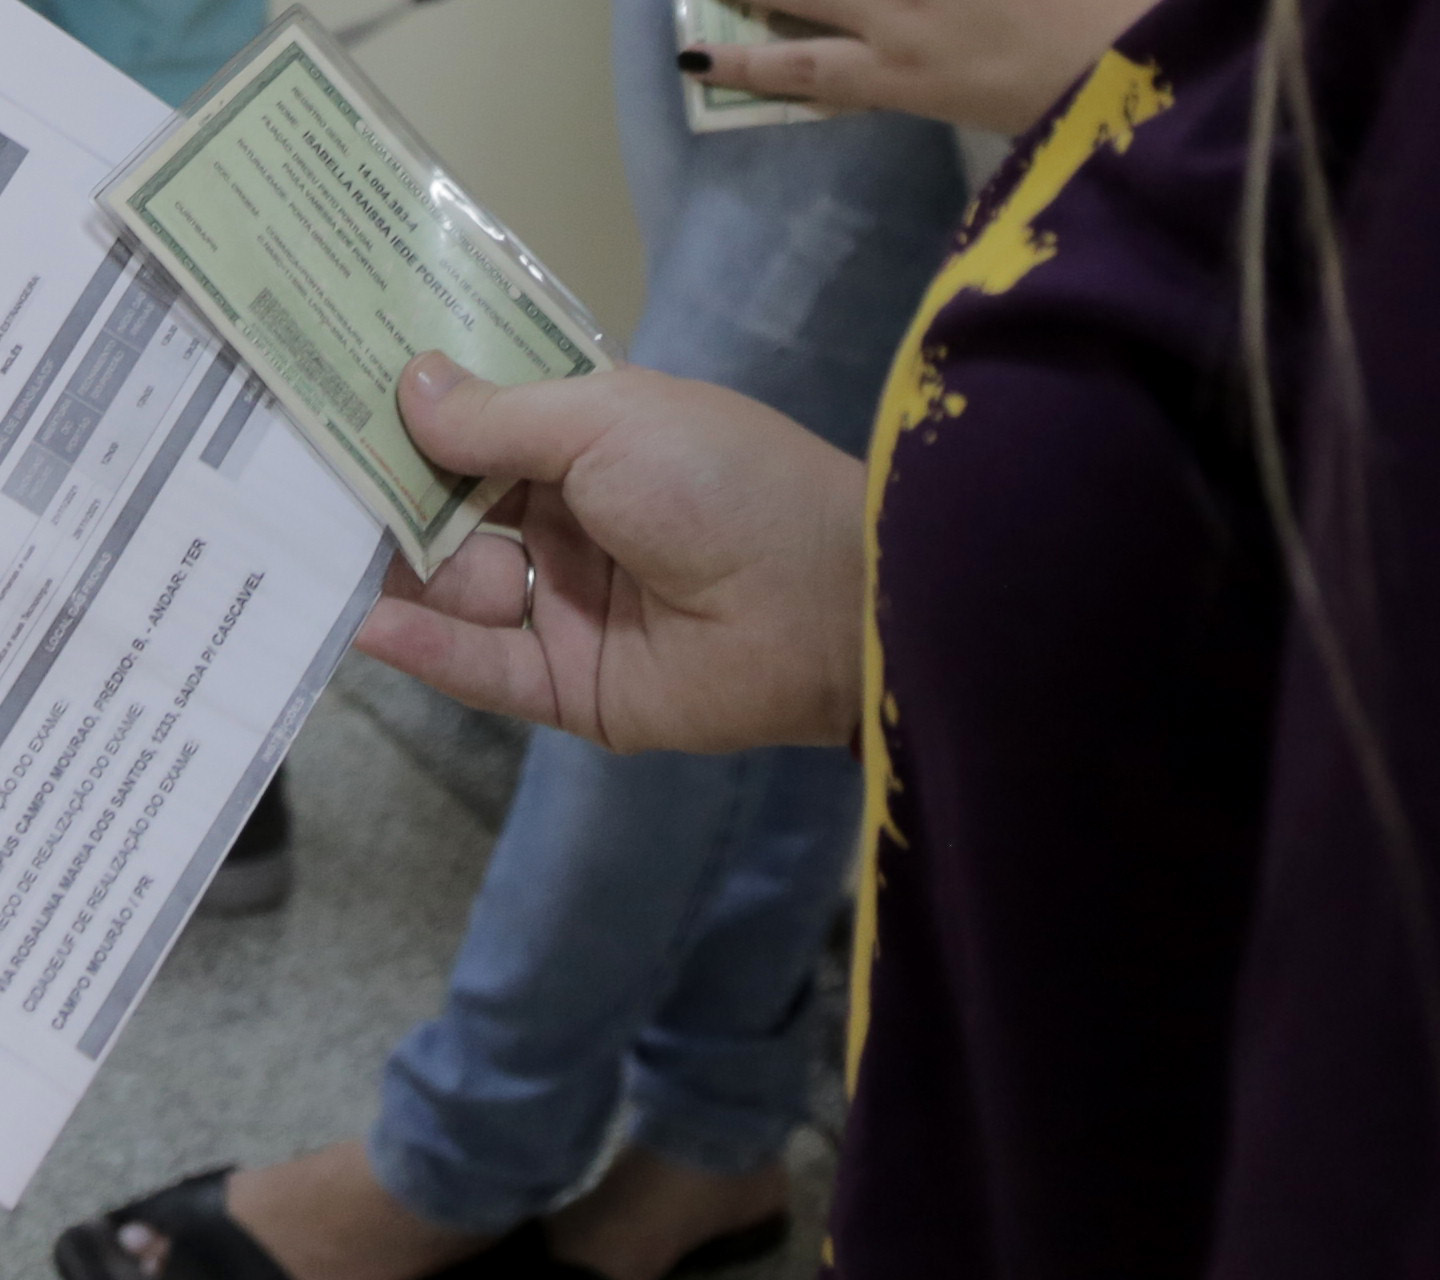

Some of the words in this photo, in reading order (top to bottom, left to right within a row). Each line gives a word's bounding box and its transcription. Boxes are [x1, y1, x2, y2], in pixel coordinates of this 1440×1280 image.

[297, 129, 359, 192] ISABELLA
[348, 188, 395, 237] RAISSA
[387, 233, 420, 267] IEDE
[412, 262, 480, 333] PORTUGAL
[42, 613, 75, 654] LOCAL
[12, 779, 56, 836] CAMPO
[89, 648, 139, 713] PRÉDIO:
[143, 567, 190, 627] ANDAR:
[179, 535, 208, 570] TER
[6, 889, 66, 970] ROSALINA
[56, 838, 97, 892] MARIA
[87, 805, 118, 842] DOS
[108, 742, 159, 809] SANTOS,
[148, 706, 182, 746] 1233,
[207, 566, 268, 648] CASCAVEL
[10, 751, 35, 779] DO
[26, 697, 70, 754] EXAME:
[156, 736, 201, 794] EXAME:
[14, 868, 38, 894] DE
[27, 776, 99, 872] REALIZAÇÃO
[87, 752, 112, 780] DO
[102, 698, 147, 756] EXAME:
[142, 791, 167, 819] DO
[81, 814, 154, 912] REALIZAÇÃO
[48, 973, 94, 1032] CAMPO
[80, 903, 136, 976] MOURÃO
[131, 872, 156, 900] PR
[69, 907, 94, 935] DE
[19, 932, 79, 1014] CIDADE/UF
